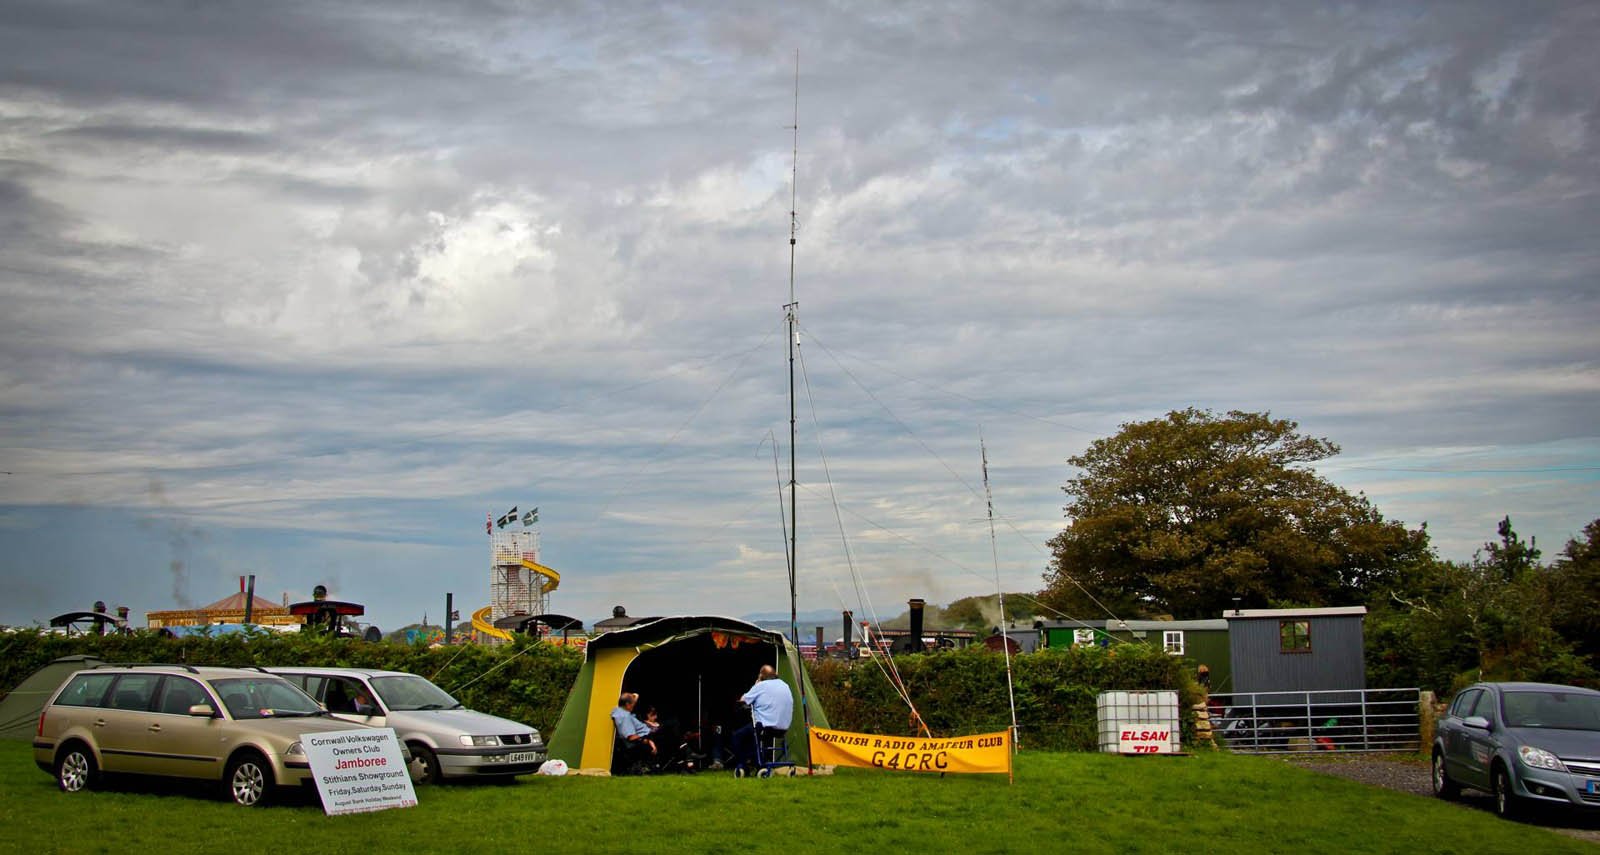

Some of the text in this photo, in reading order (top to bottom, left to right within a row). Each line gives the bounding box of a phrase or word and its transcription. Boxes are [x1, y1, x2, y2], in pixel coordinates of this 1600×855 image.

[311, 734, 388, 746] Cornwall Volkswagen
[815, 731, 1003, 750] CORNISH RADIO AMATEUR CLUB
[1121, 731, 1169, 741] ELSAN
[332, 745, 381, 756] Owners Club
[335, 757, 387, 769] Jamboree
[872, 751, 948, 770] G4CRC
[322, 770, 404, 784] Stithians Showground
